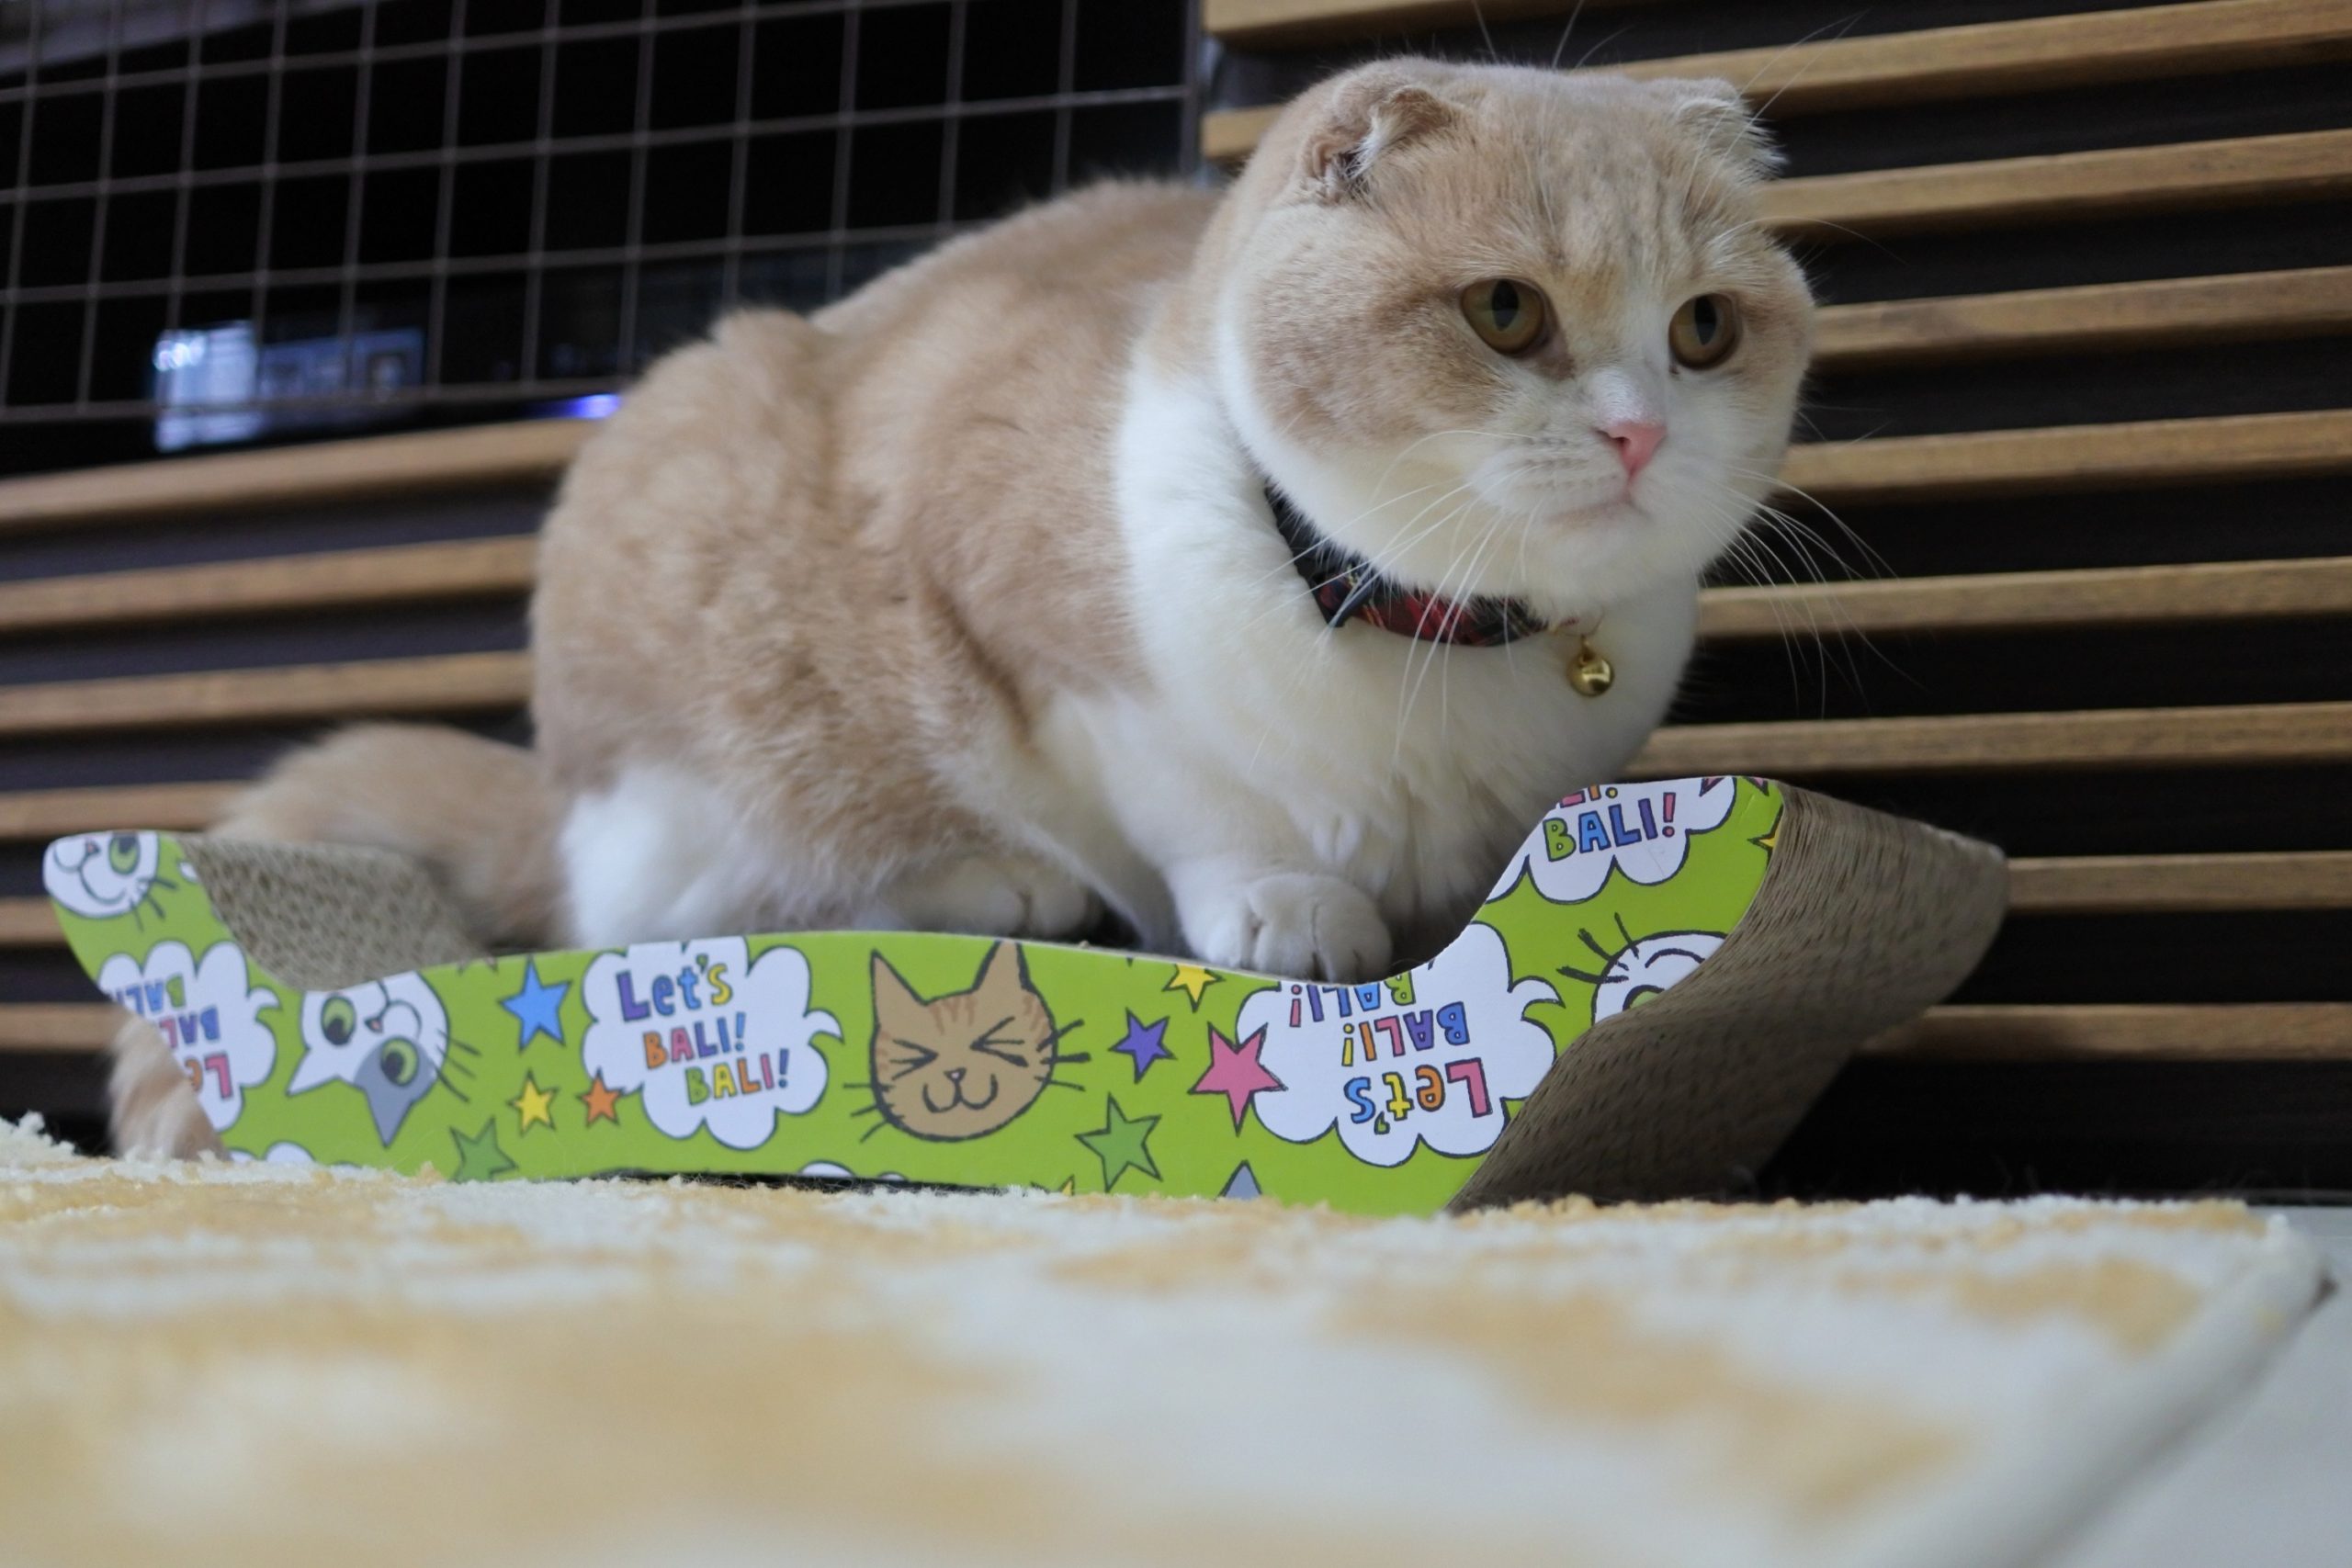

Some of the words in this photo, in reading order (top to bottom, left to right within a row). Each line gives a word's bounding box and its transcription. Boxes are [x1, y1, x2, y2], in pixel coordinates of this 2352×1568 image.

[1543, 791, 1676, 862] BALI!
[616, 953, 733, 1022] Let's
[642, 1011, 746, 1070] BALI!
[1341, 1001, 1470, 1066] BALI!
[685, 1048, 789, 1106] BALI!
[1343, 1057, 1493, 1135] Let's
